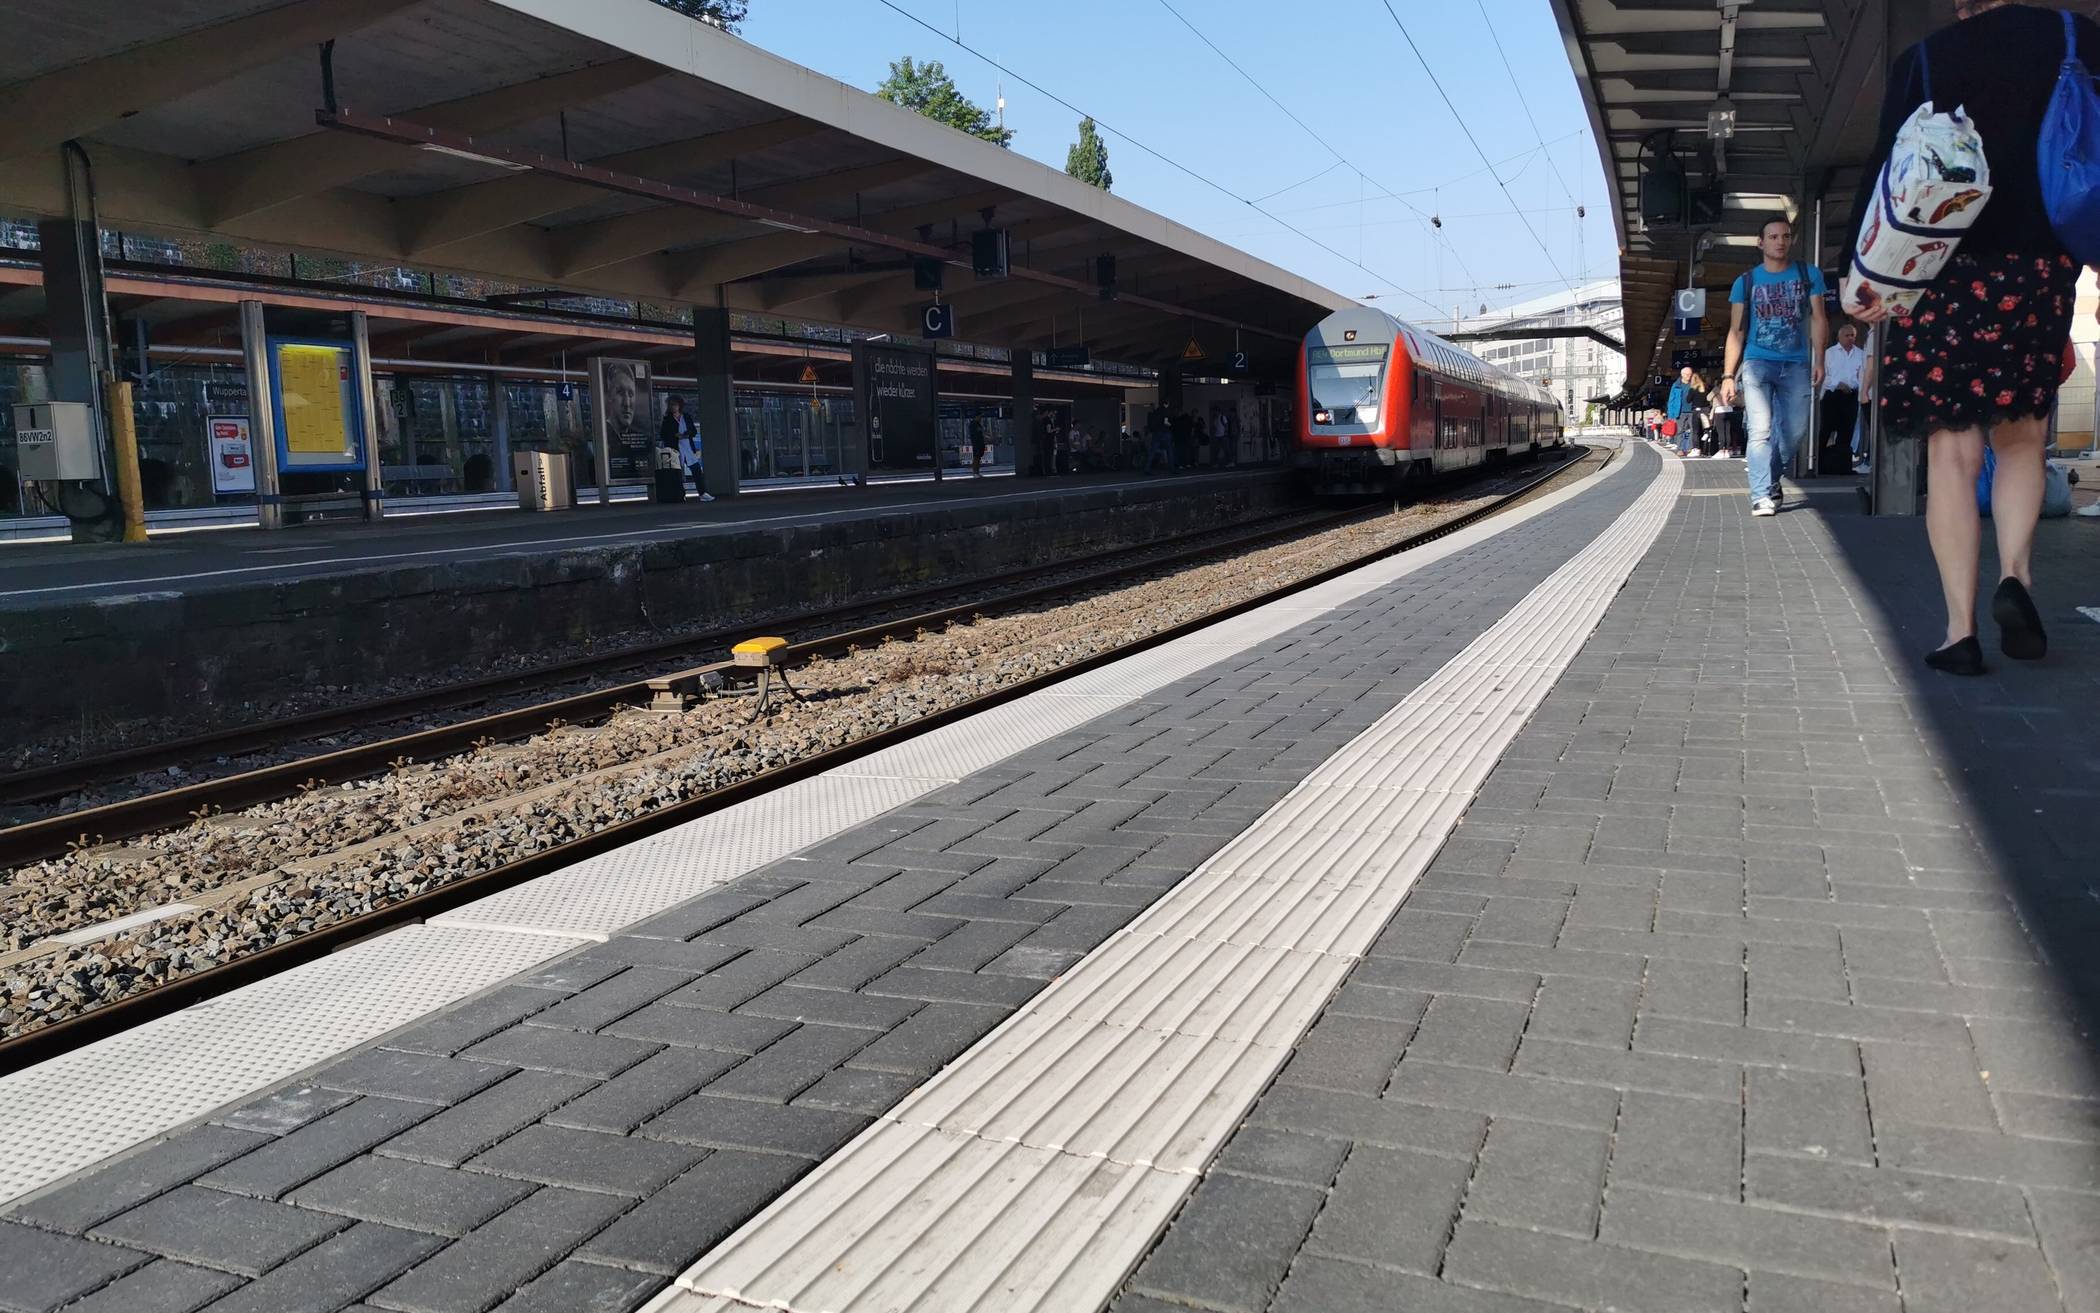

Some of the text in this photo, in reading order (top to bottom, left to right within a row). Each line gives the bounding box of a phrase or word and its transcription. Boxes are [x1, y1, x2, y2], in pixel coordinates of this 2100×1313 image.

[1680, 290, 1696, 312] C
[925, 306, 942, 331] C
[1235, 352, 1245, 368] 2
[1330, 347, 1369, 359] Dortmund
[1655, 376, 1662, 384] D
[562, 384, 571, 397] 4
[537, 467, 547, 501] Abfall
